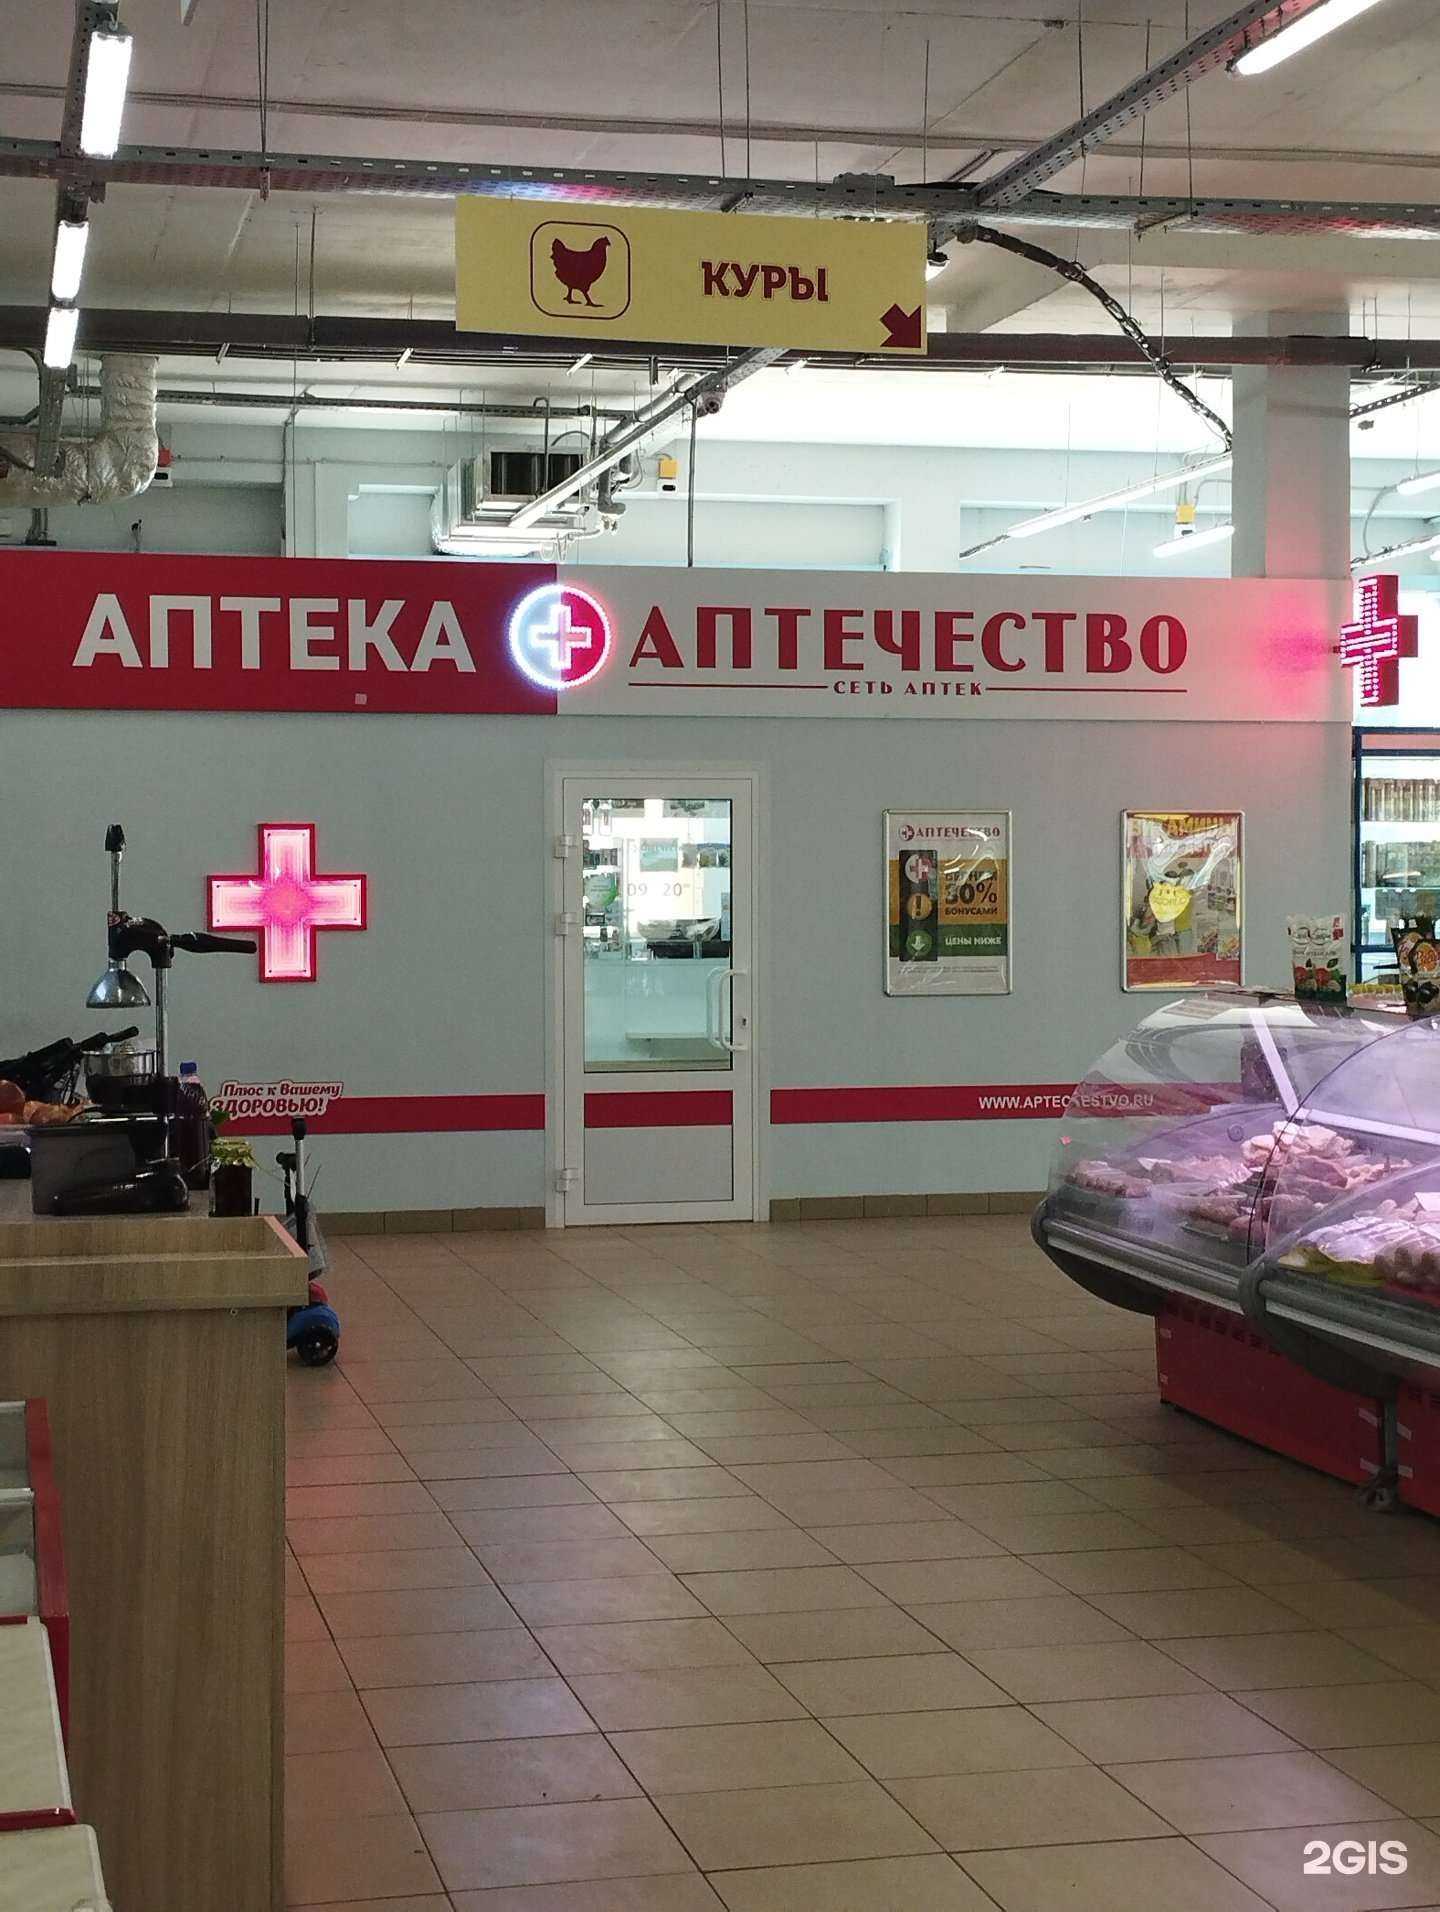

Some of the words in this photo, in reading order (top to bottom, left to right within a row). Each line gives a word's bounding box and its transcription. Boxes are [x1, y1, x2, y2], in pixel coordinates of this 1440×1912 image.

[701, 260, 829, 302] КУРЫ
[72, 593, 476, 672] АПТЕКА
[629, 605, 1188, 674] АПТЕЧЕСТВО
[833, 680, 893, 694] СЕТЬ
[904, 682, 982, 696] АПТЕК
[915, 826, 1001, 839] АПТЕЧЕВО
[944, 907, 998, 916] БОНУСАМИ
[945, 936, 972, 947] ЦЕНЫ
[974, 936, 1002, 946] НИЖЕ
[223, 1084, 264, 1097] Плюс
[267, 1086, 277, 1096] к
[280, 1083, 342, 1099] Вашему
